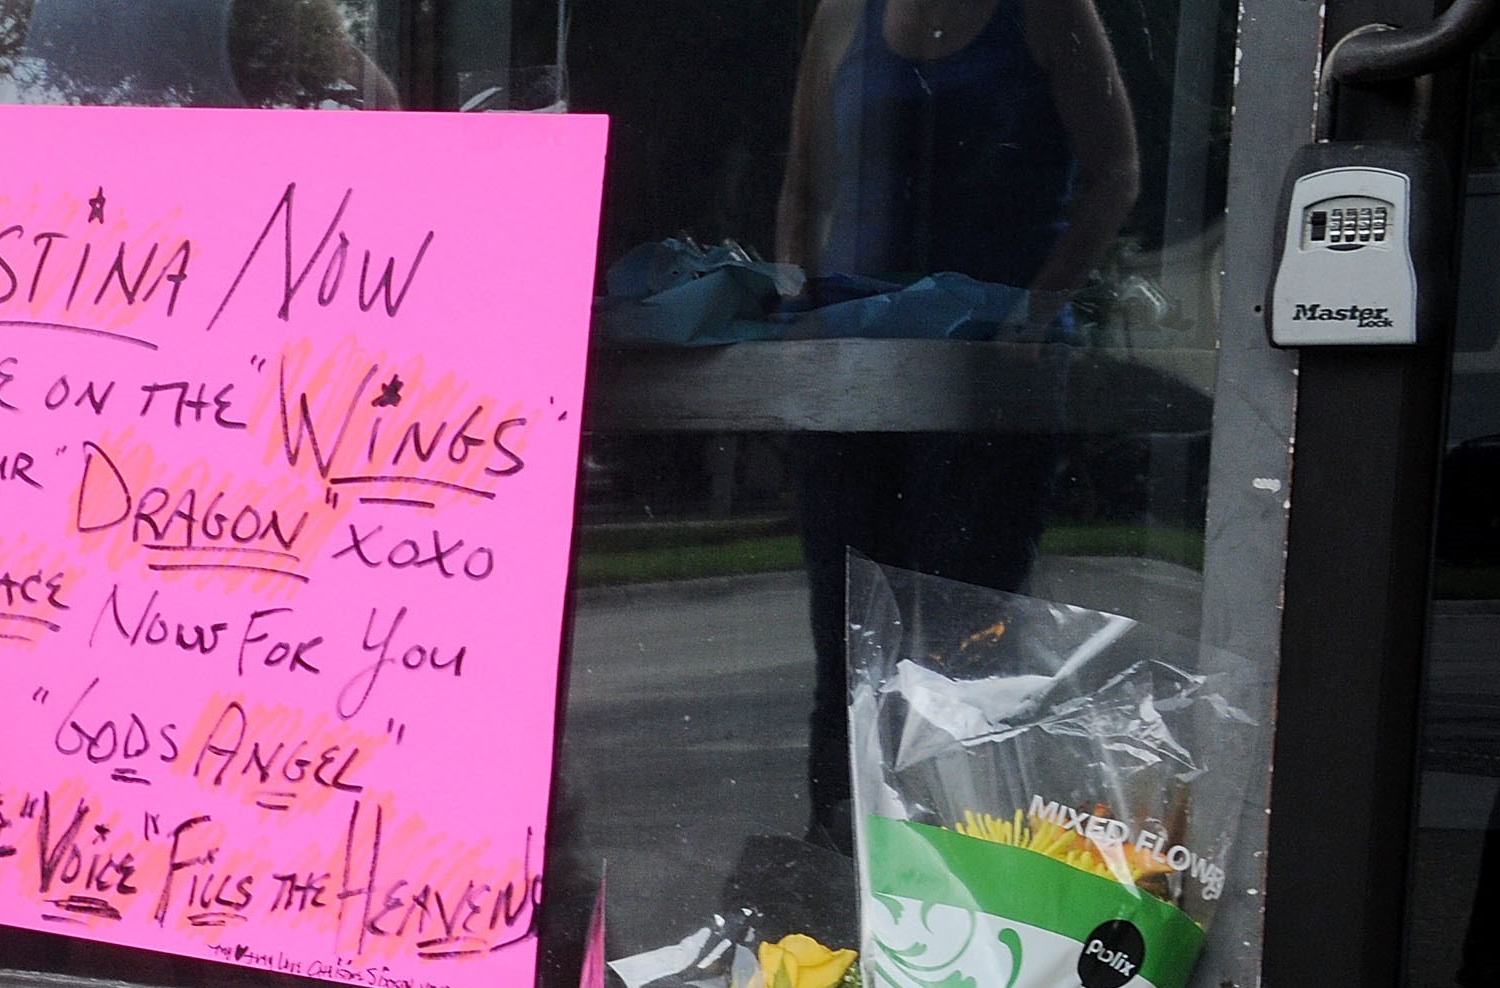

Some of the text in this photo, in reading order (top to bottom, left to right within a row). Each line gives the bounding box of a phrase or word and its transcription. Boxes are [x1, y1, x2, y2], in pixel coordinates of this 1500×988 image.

[1292, 304, 1388, 321] Master
[1357, 318, 1393, 328] Lock
[44, 375, 115, 414] ON
[141, 382, 247, 429] THE
[1029, 795, 1130, 846] MIXED
[271, 873, 330, 912] THE
[1086, 939, 1135, 977] polix
